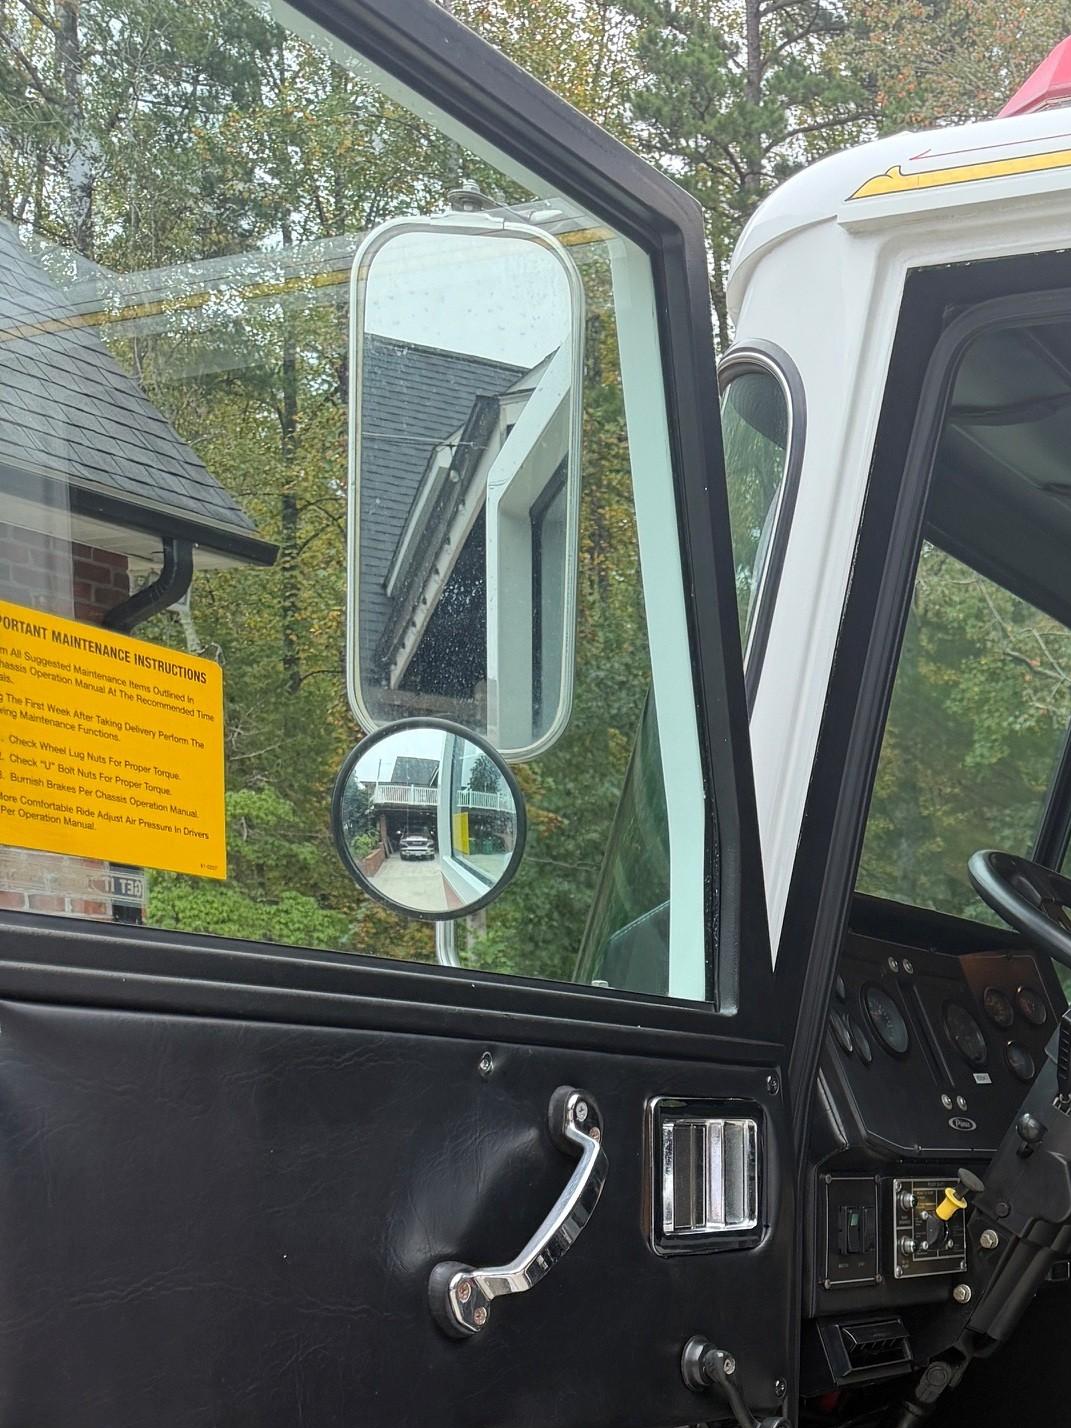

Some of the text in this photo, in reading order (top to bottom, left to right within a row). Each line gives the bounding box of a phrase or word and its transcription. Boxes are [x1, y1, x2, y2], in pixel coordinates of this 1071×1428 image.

[0, 615, 207, 684] ORTANT MAINTENANCE INSTRUCTIONS
[0, 659, 26, 674] hassis
[30, 666, 72, 685] Operation
[75, 678, 105, 693] Manual
[108, 687, 117, 696] At
[119, 689, 134, 702] The
[136, 694, 195, 717] Recommended
[197, 710, 214, 722] Time
[10, 648, 22, 658] All
[24, 651, 71, 671] Suggested
[74, 664, 127, 686] Maintenance
[129, 680, 151, 693] Items
[153, 686, 185, 703] Outlined
[187, 695, 195, 704] In
[6, 693, 23, 705] The
[25, 697, 44, 710] First
[47, 703, 71, 717] Week
[73, 710, 93, 721] After
[96, 714, 122, 731] Taking
[124, 722, 157, 739] Delivery
[158, 730, 189, 745] Perform
[191, 738, 205, 749] The
[19, 709, 75, 731] Maintenance
[78, 723, 120, 742] Functions.
[9, 734, 181, 781] Check Wheel Lug Nuts For Proper Torque.
[9, 753, 38, 768] Check
[58, 764, 75, 775] Bolt
[77, 768, 97, 780] Nuts
[99, 773, 113, 783] For
[115, 776, 142, 789] Proper
[144, 782, 172, 796] Torque.
[10, 772, 44, 788] Burnish
[46, 780, 76, 794] Brakes
[78, 785, 94, 797] Per
[95, 789, 127, 804] Chassis
[129, 796, 168, 812] Operation
[0, 805, 97, 831] Per Operation Manual.
[20, 795, 74, 814] Comfortable
[76, 806, 95, 818] Ride
[97, 810, 123, 824] Adjust
[125, 815, 136, 825] Air
[138, 818, 172, 833] Pressure
[174, 825, 182, 835] In
[183, 827, 209, 840] Drivers
